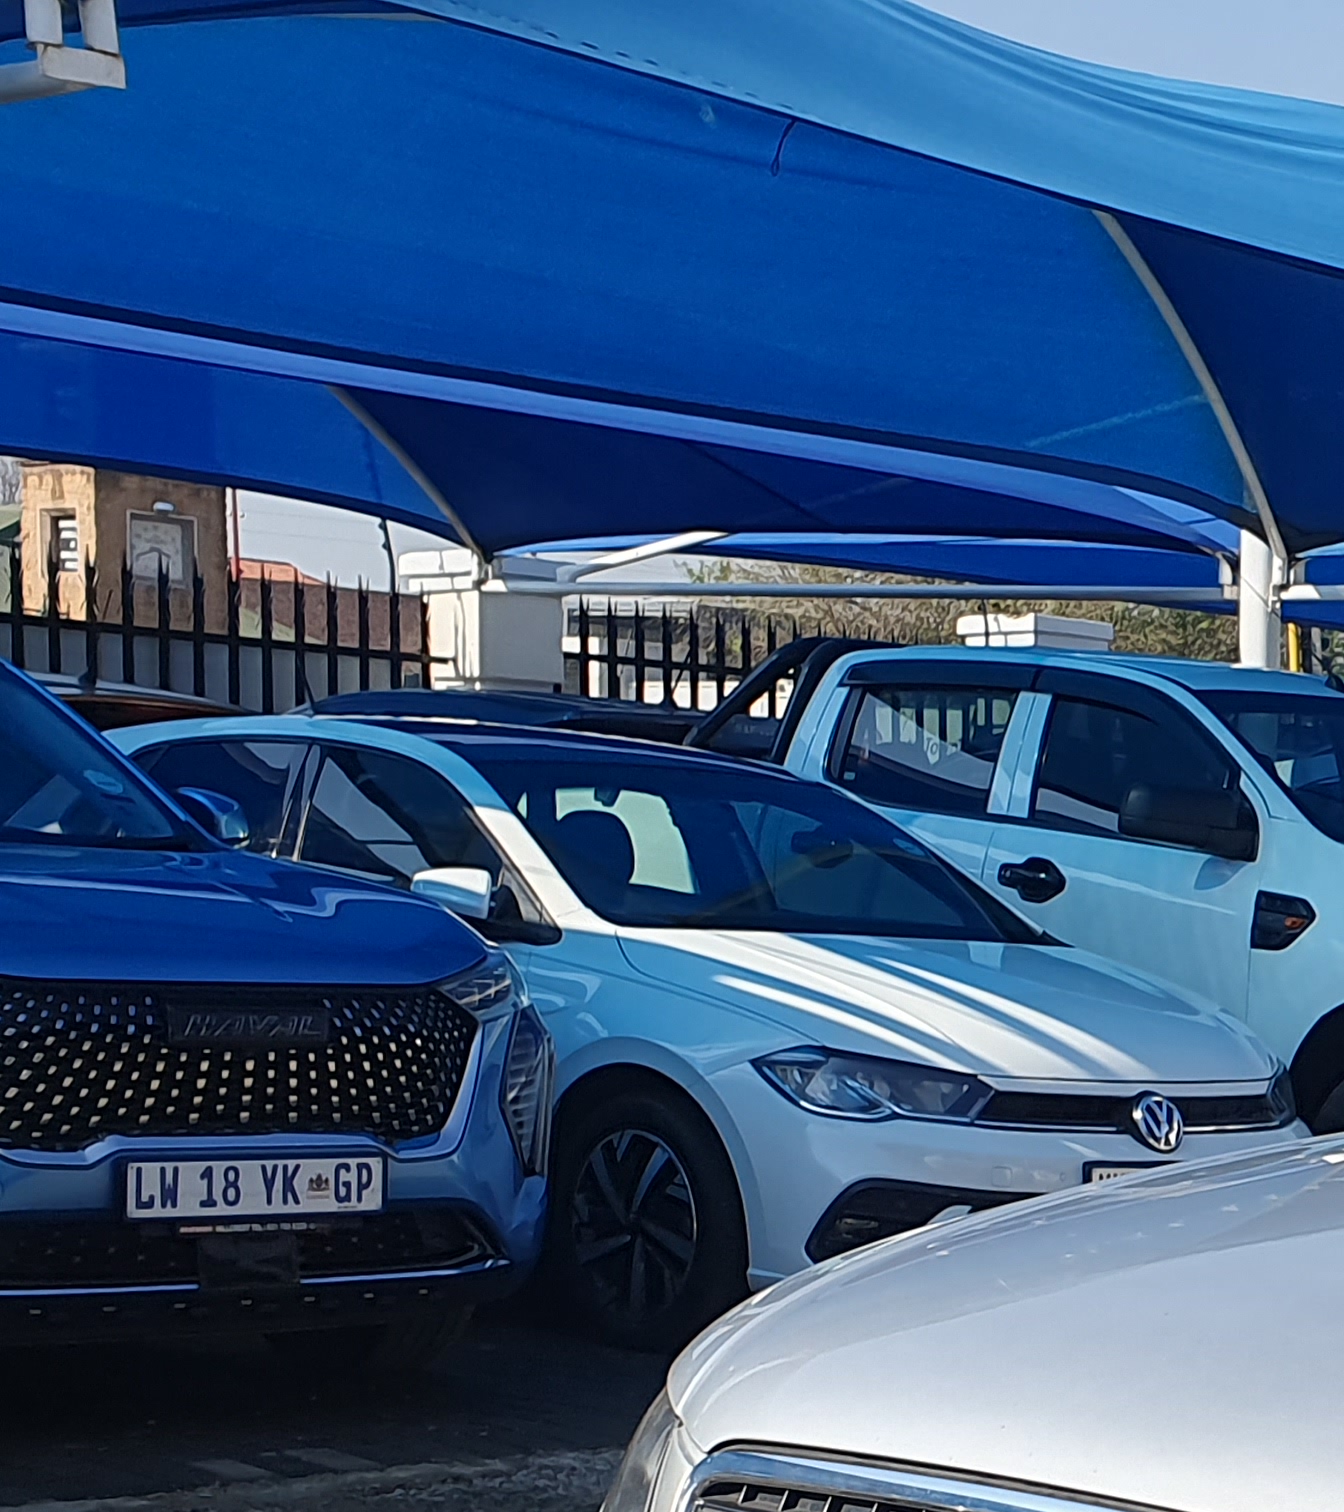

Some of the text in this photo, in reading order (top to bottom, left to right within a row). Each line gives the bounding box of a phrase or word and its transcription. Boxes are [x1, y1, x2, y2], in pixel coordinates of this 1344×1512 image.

[184, 1014, 322, 1037] HAVAL
[135, 1162, 373, 1210] LW 18 YK GP
